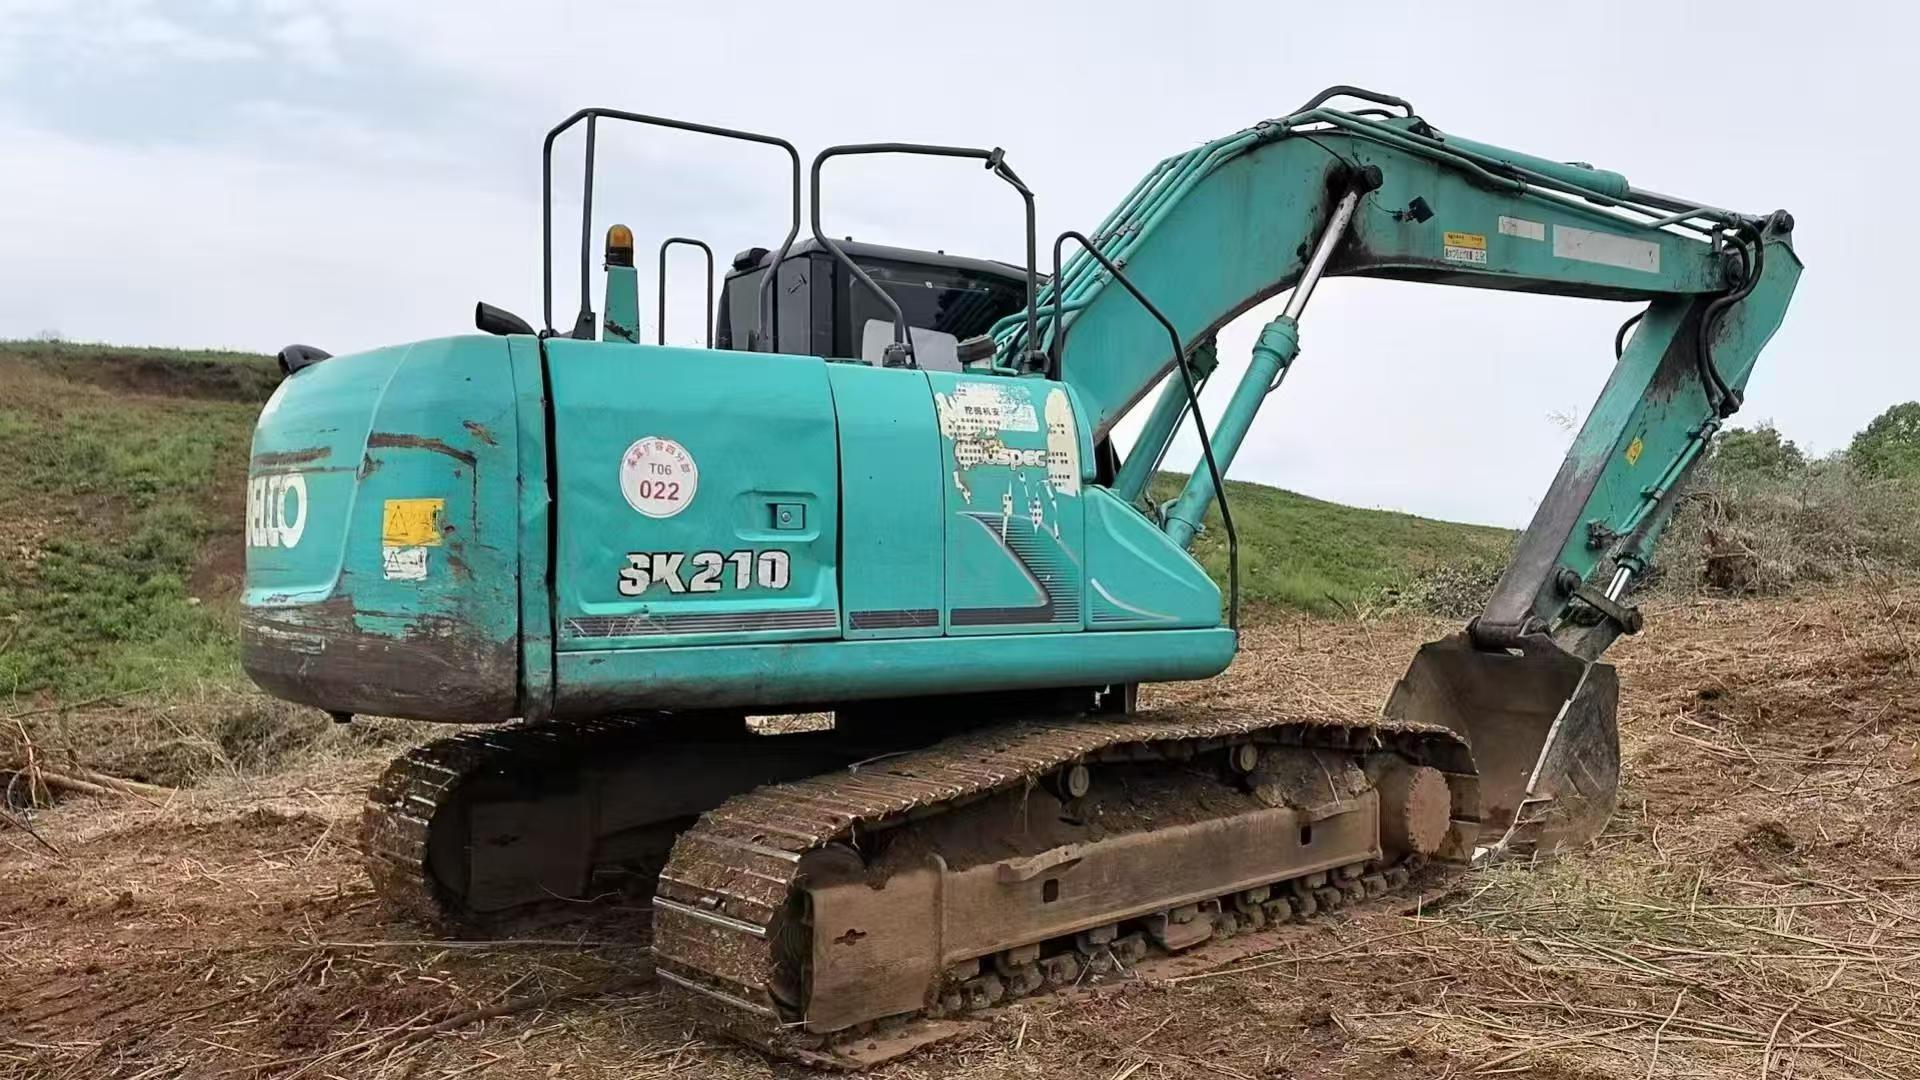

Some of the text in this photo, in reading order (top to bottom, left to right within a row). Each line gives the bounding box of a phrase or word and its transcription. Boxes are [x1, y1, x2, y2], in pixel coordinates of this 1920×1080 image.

[648, 462, 672, 476] T06
[639, 480, 680, 501] 022
[618, 550, 791, 597] SK210
